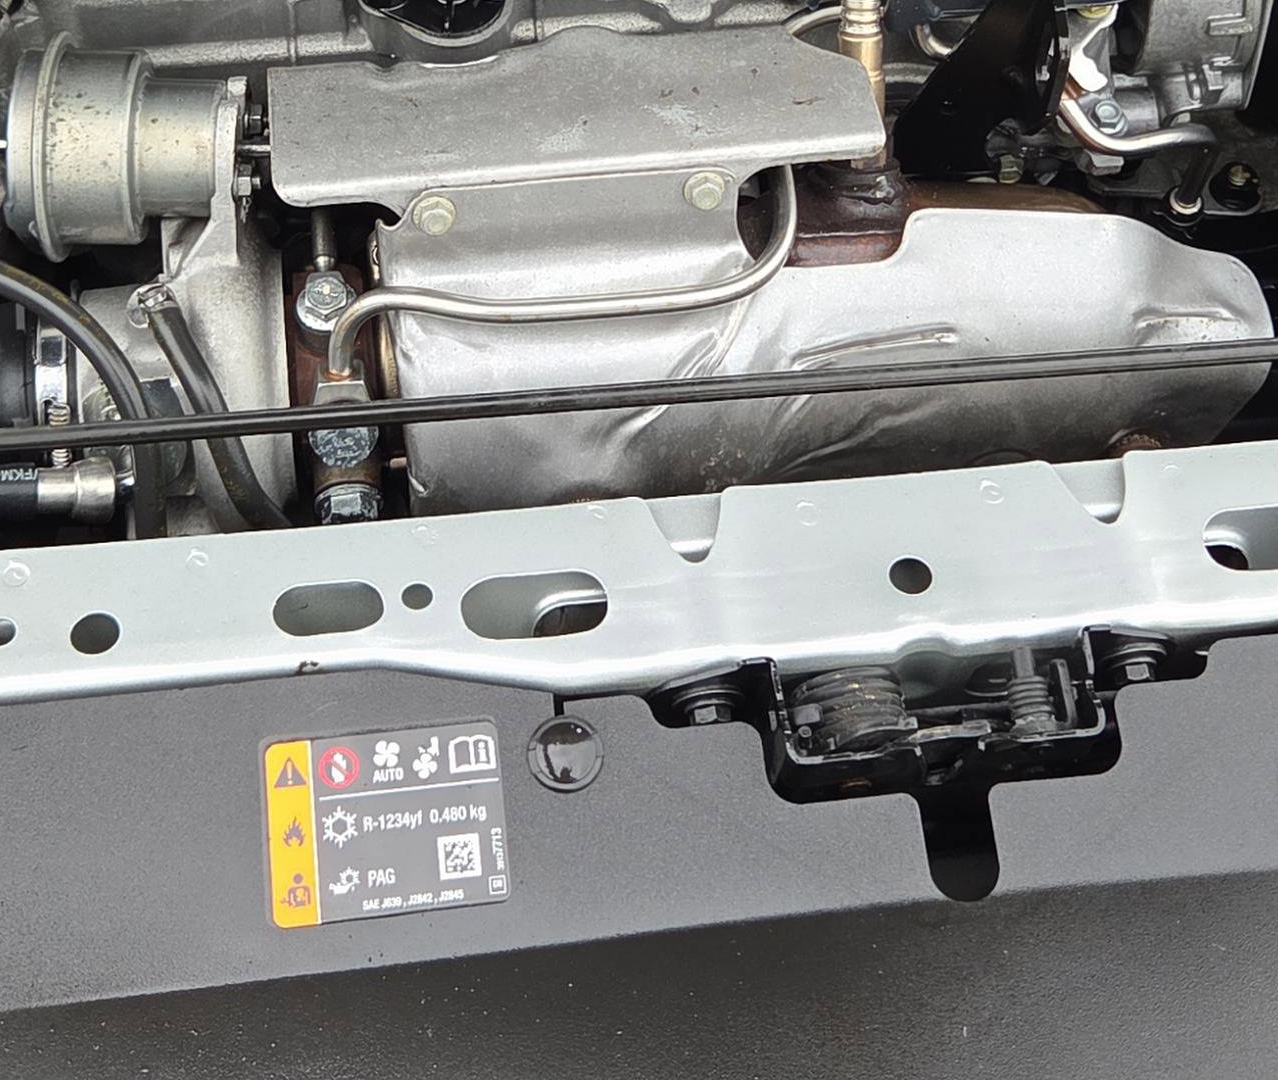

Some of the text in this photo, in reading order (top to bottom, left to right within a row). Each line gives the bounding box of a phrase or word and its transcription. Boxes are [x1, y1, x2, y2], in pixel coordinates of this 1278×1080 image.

[373, 767, 404, 784] AUTO
[469, 803, 487, 821] kg
[367, 867, 397, 888] PAG
[362, 899, 380, 910] SAE
